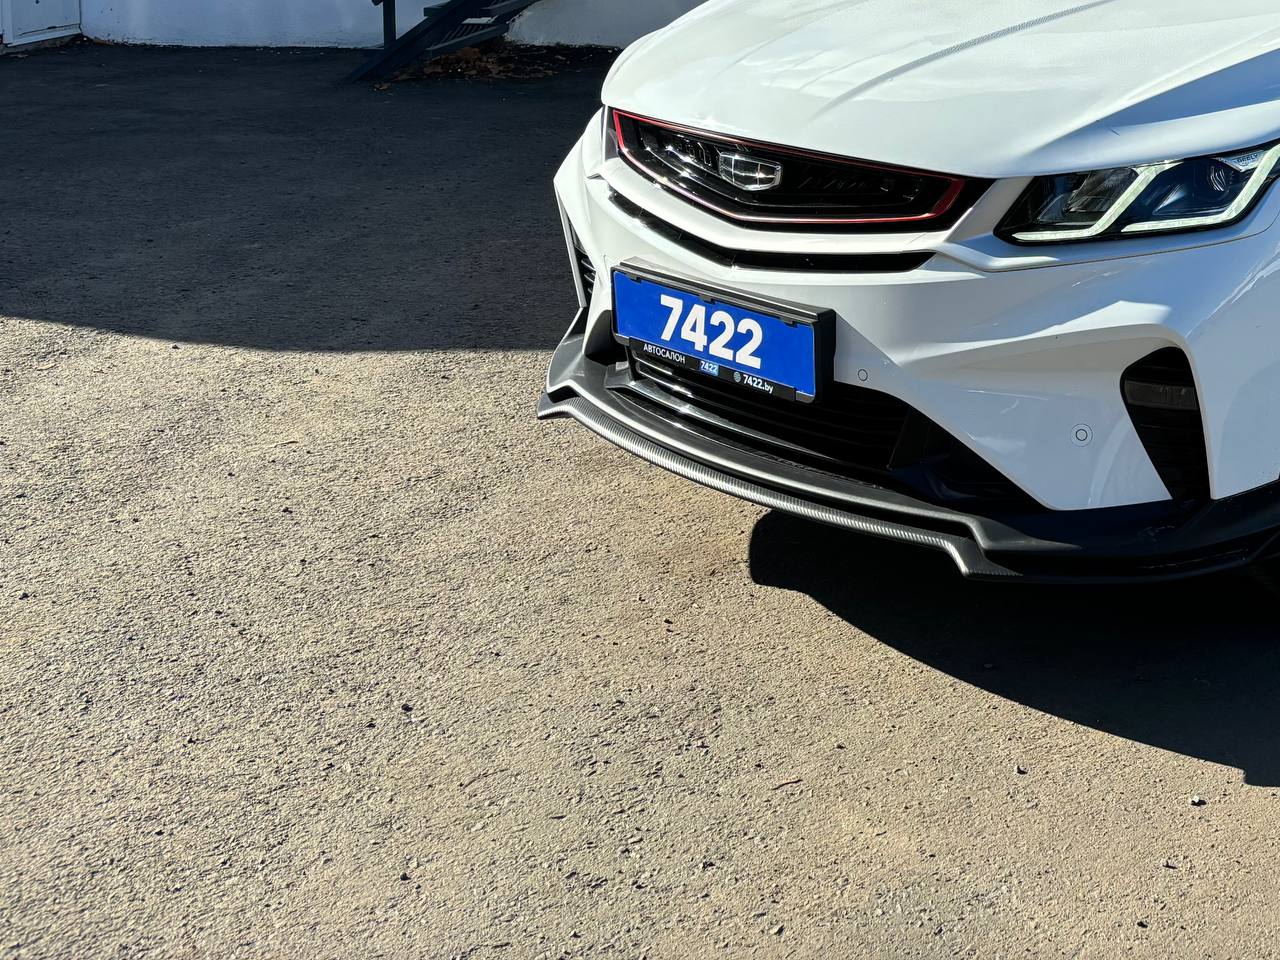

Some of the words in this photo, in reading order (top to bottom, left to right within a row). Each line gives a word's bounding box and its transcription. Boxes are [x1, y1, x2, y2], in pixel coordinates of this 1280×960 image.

[660, 294, 763, 369] 7422
[643, 343, 686, 365] АВТОСАЛОН
[700, 360, 718, 374] 7422
[743, 374, 774, 394] 7422.by
